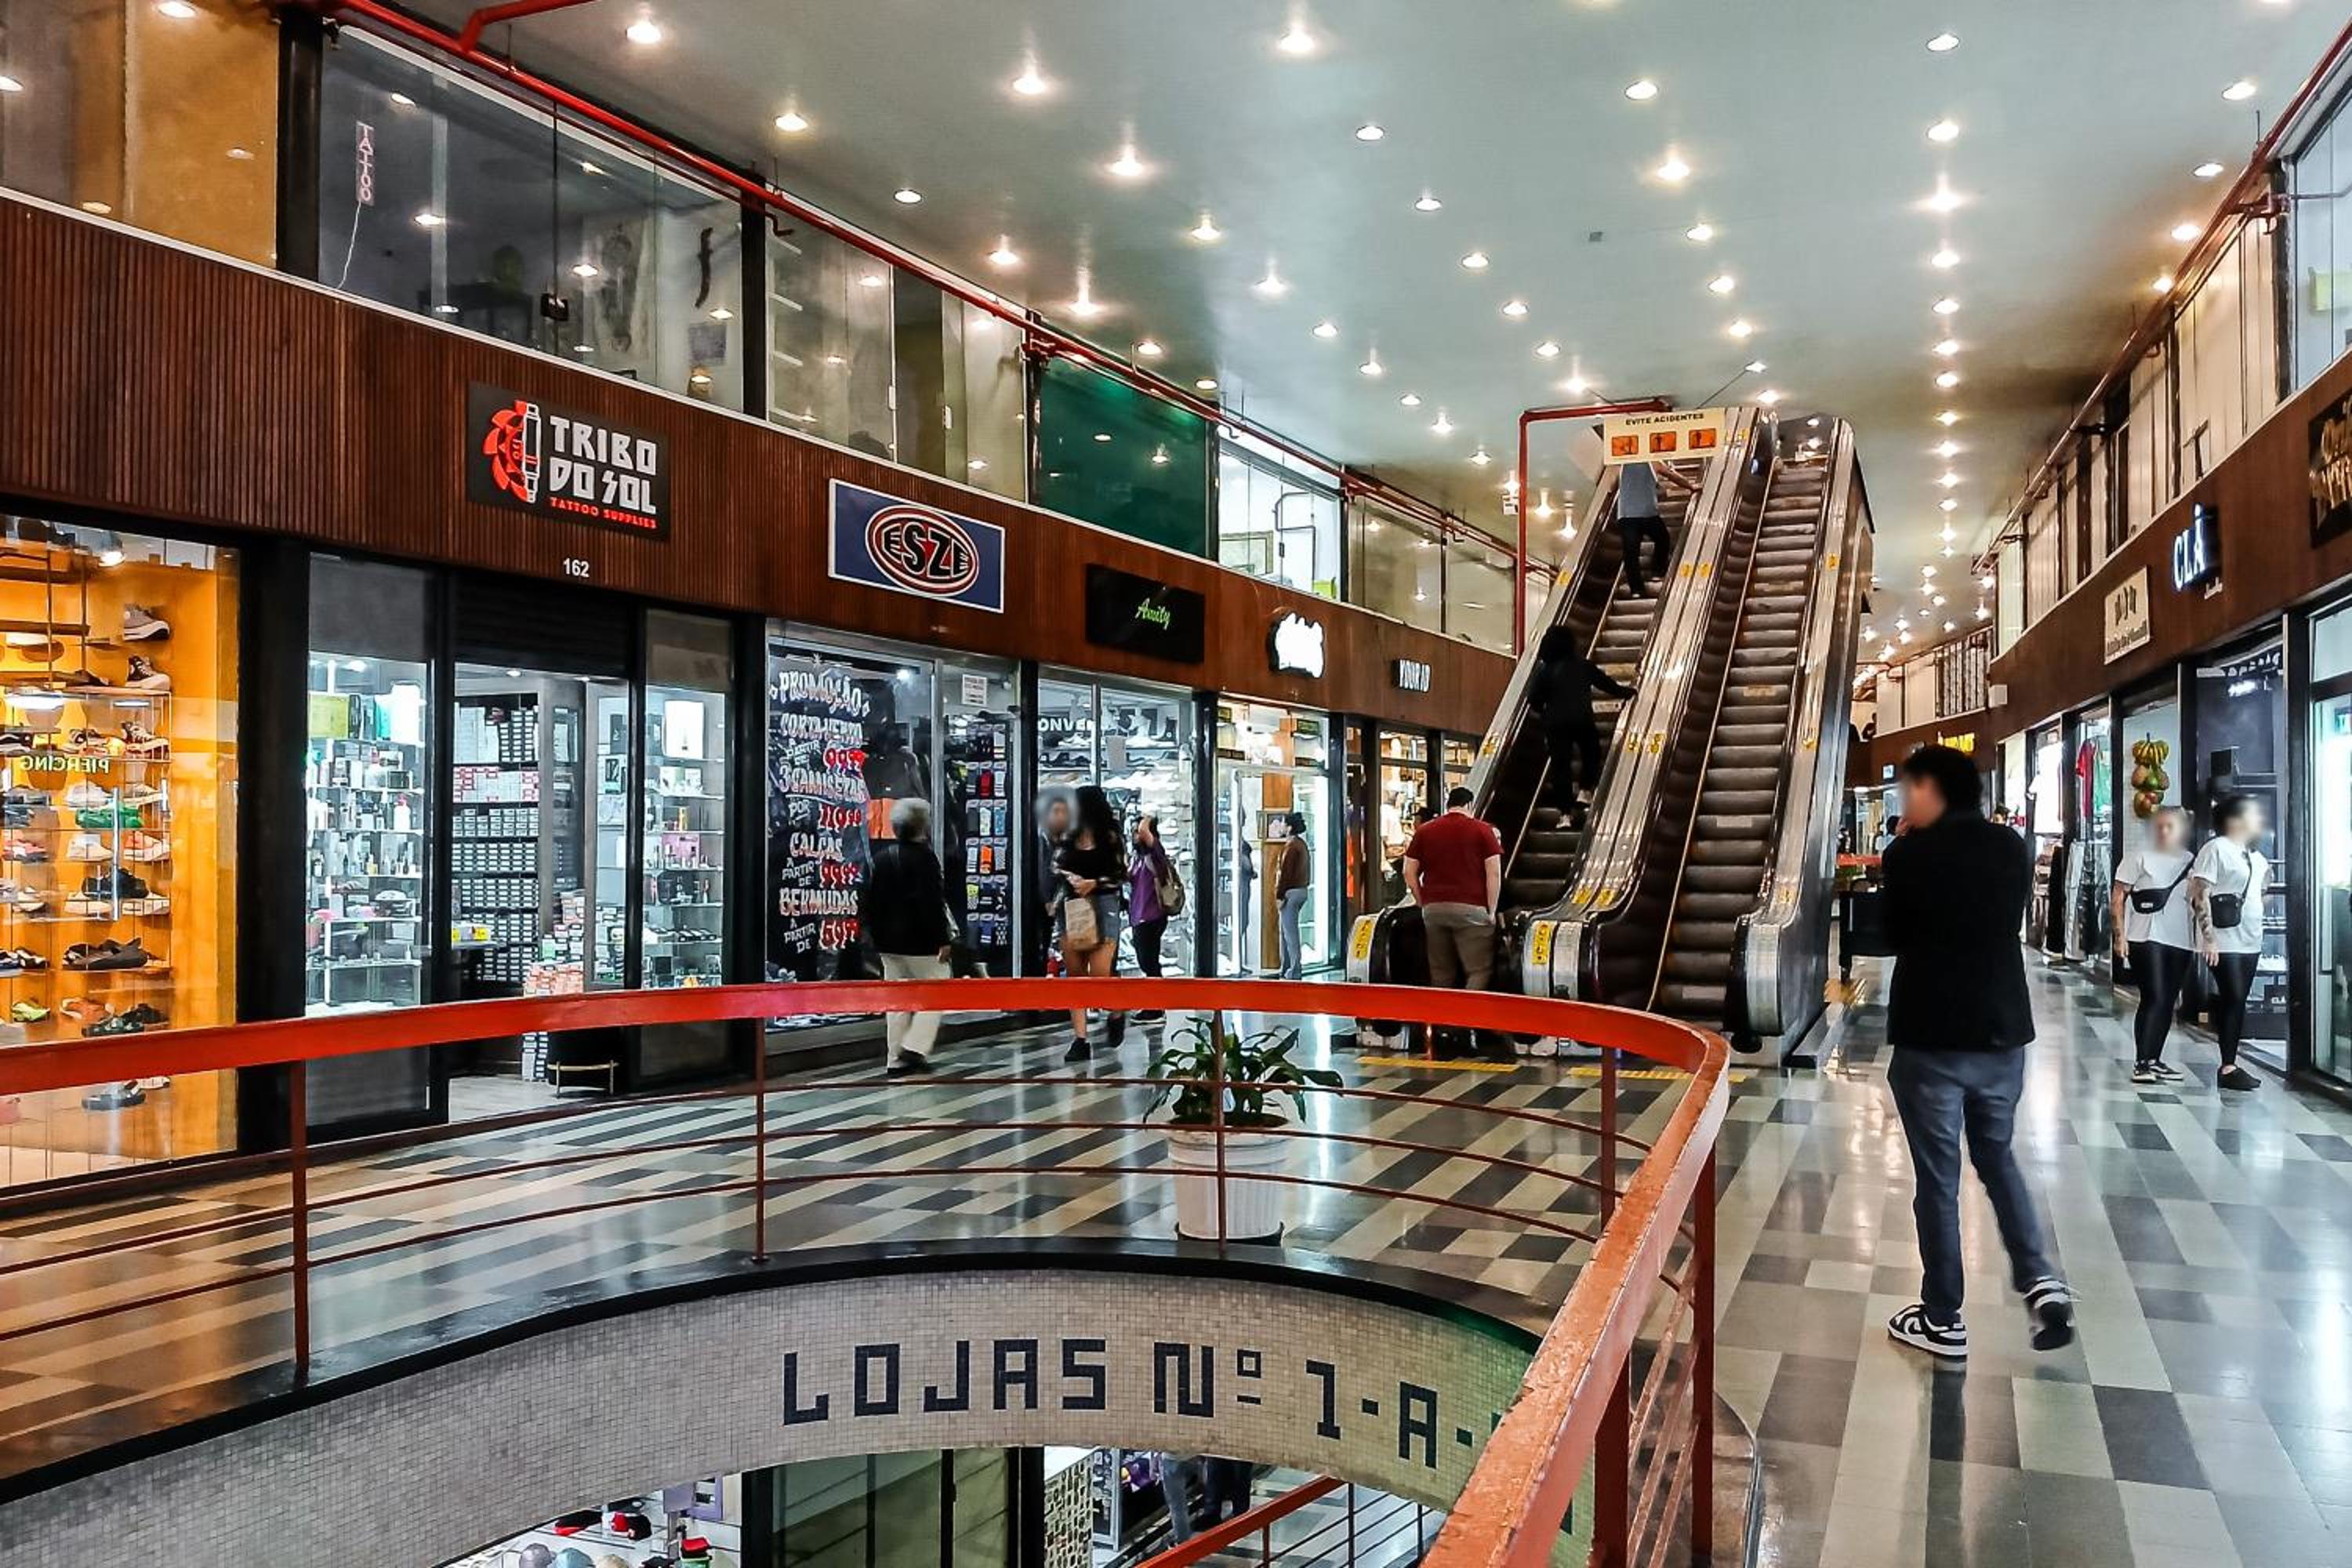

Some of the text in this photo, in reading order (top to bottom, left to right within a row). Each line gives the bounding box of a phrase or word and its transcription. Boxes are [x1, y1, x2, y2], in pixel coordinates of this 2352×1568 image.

[357, 120, 374, 201] TATTOO
[1625, 413, 1704, 426] EVITE ACIDENTES
[550, 415, 657, 476] TRIBO
[550, 456, 657, 515] DO SOL
[550, 496, 658, 529] TATTOO SUPPLIES
[563, 557, 590, 578] 162
[779, 764, 789, 793] 3
[789, 832, 845, 864] CALÇAS
[782, 860, 815, 880] PARTIR
[798, 876, 814, 887] DE
[779, 887, 858, 916] BERMUDAS
[784, 922, 816, 944] PARTIR
[796, 938, 811, 953] DE
[783, 1338, 1105, 1425] LOJAS
